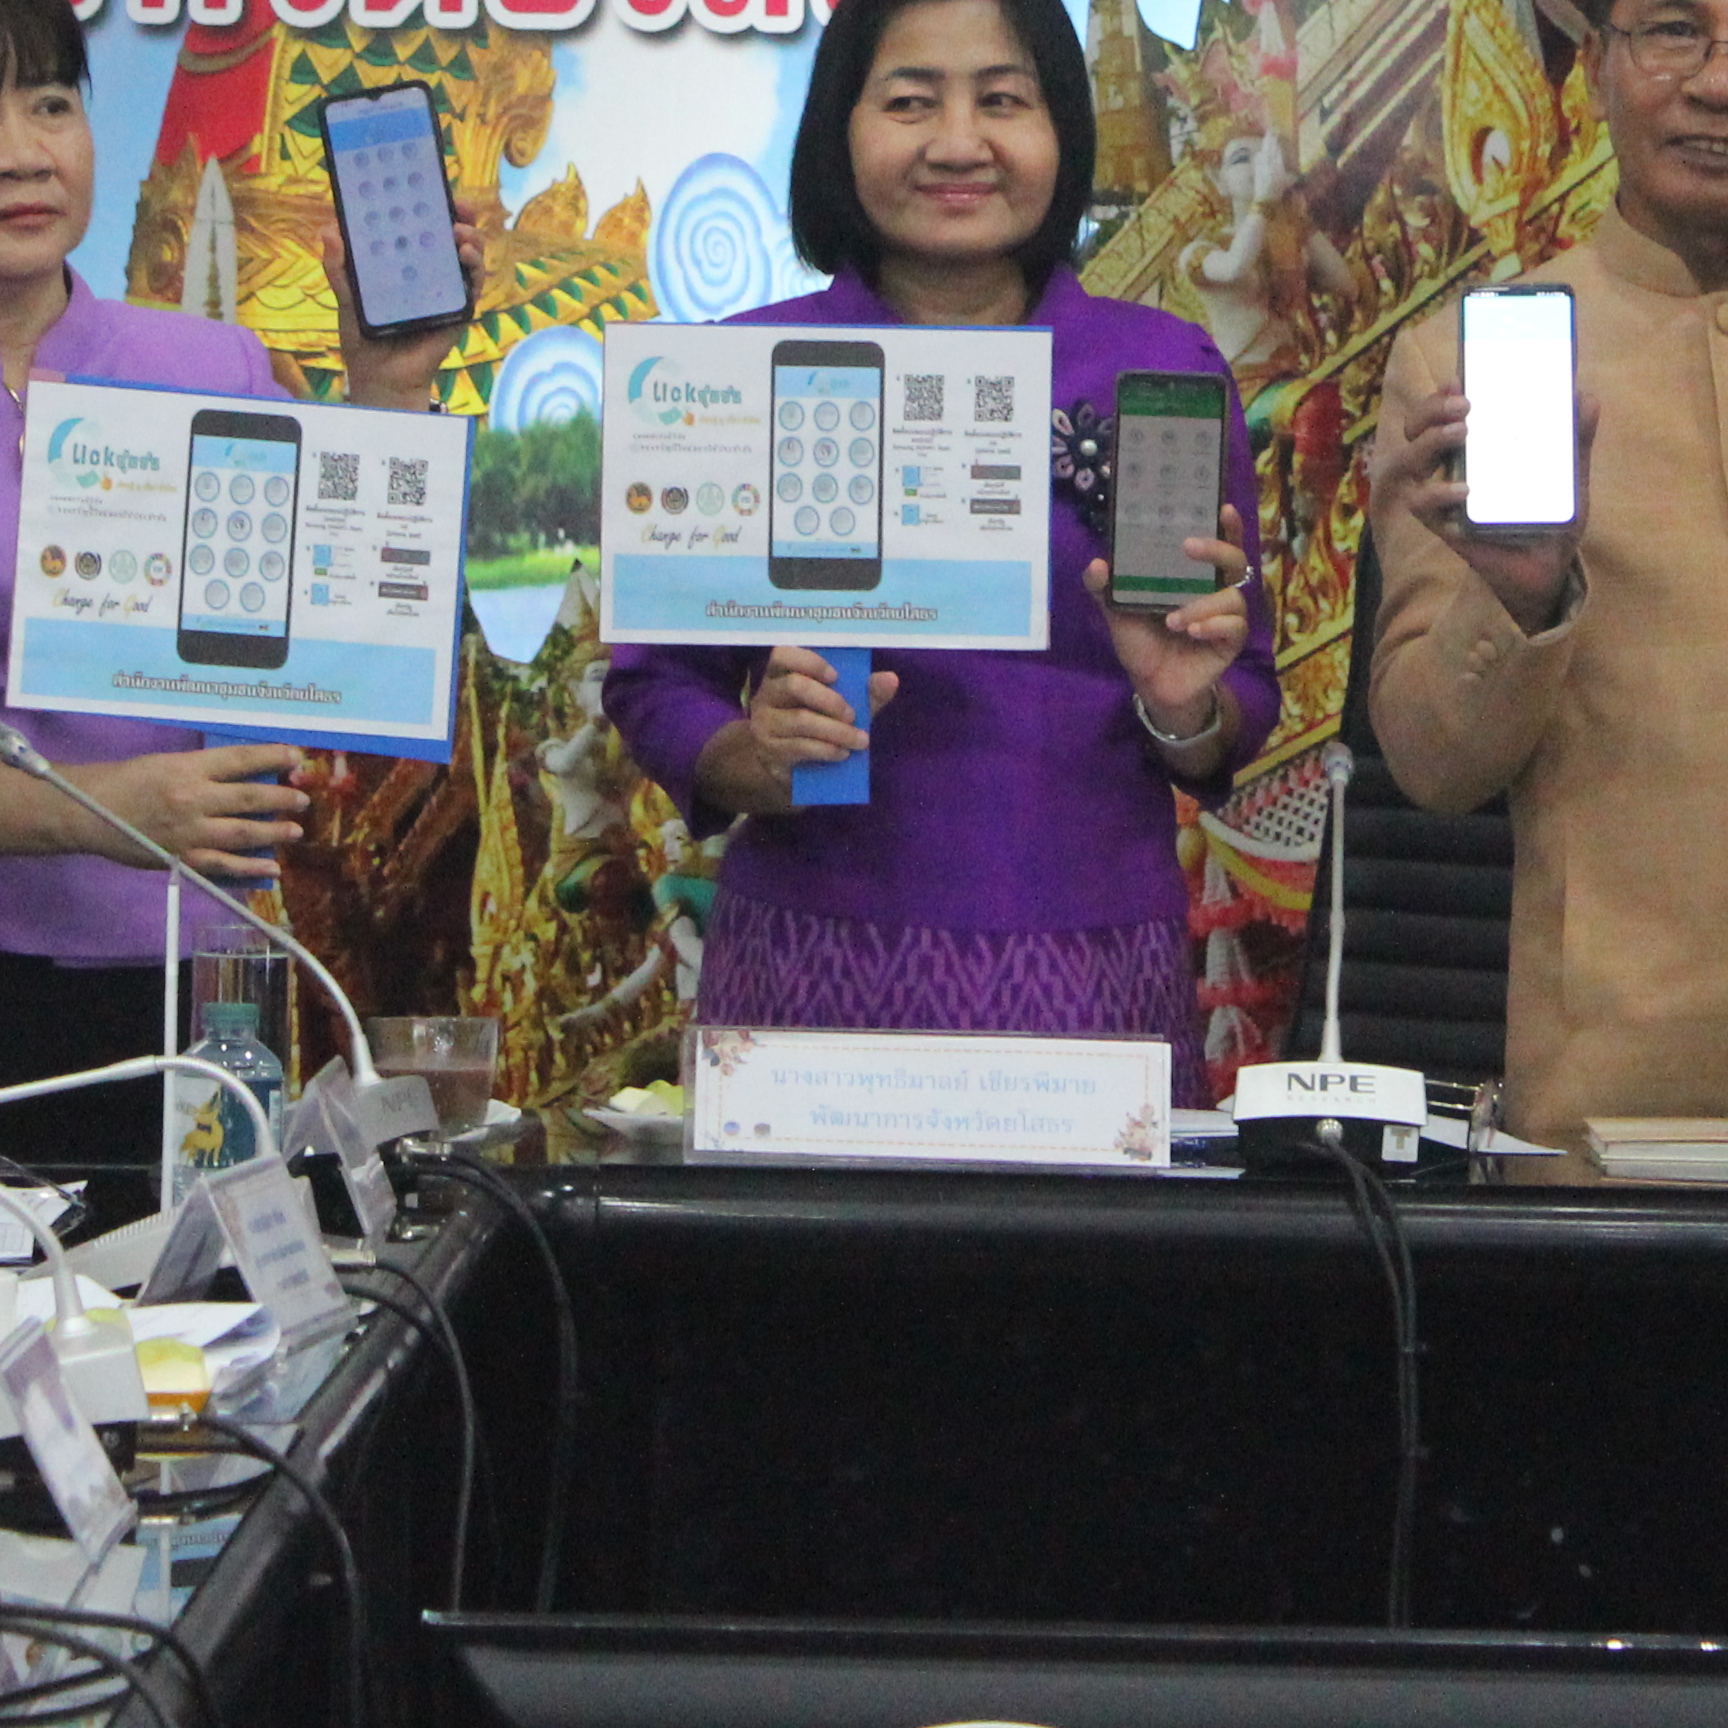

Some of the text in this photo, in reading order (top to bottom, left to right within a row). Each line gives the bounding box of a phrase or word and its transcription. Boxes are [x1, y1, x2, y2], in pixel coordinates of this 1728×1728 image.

[642, 524, 741, 549] Change for Good
[53, 588, 152, 617] Change for Good
[1287, 1072, 1376, 1094] NPE
